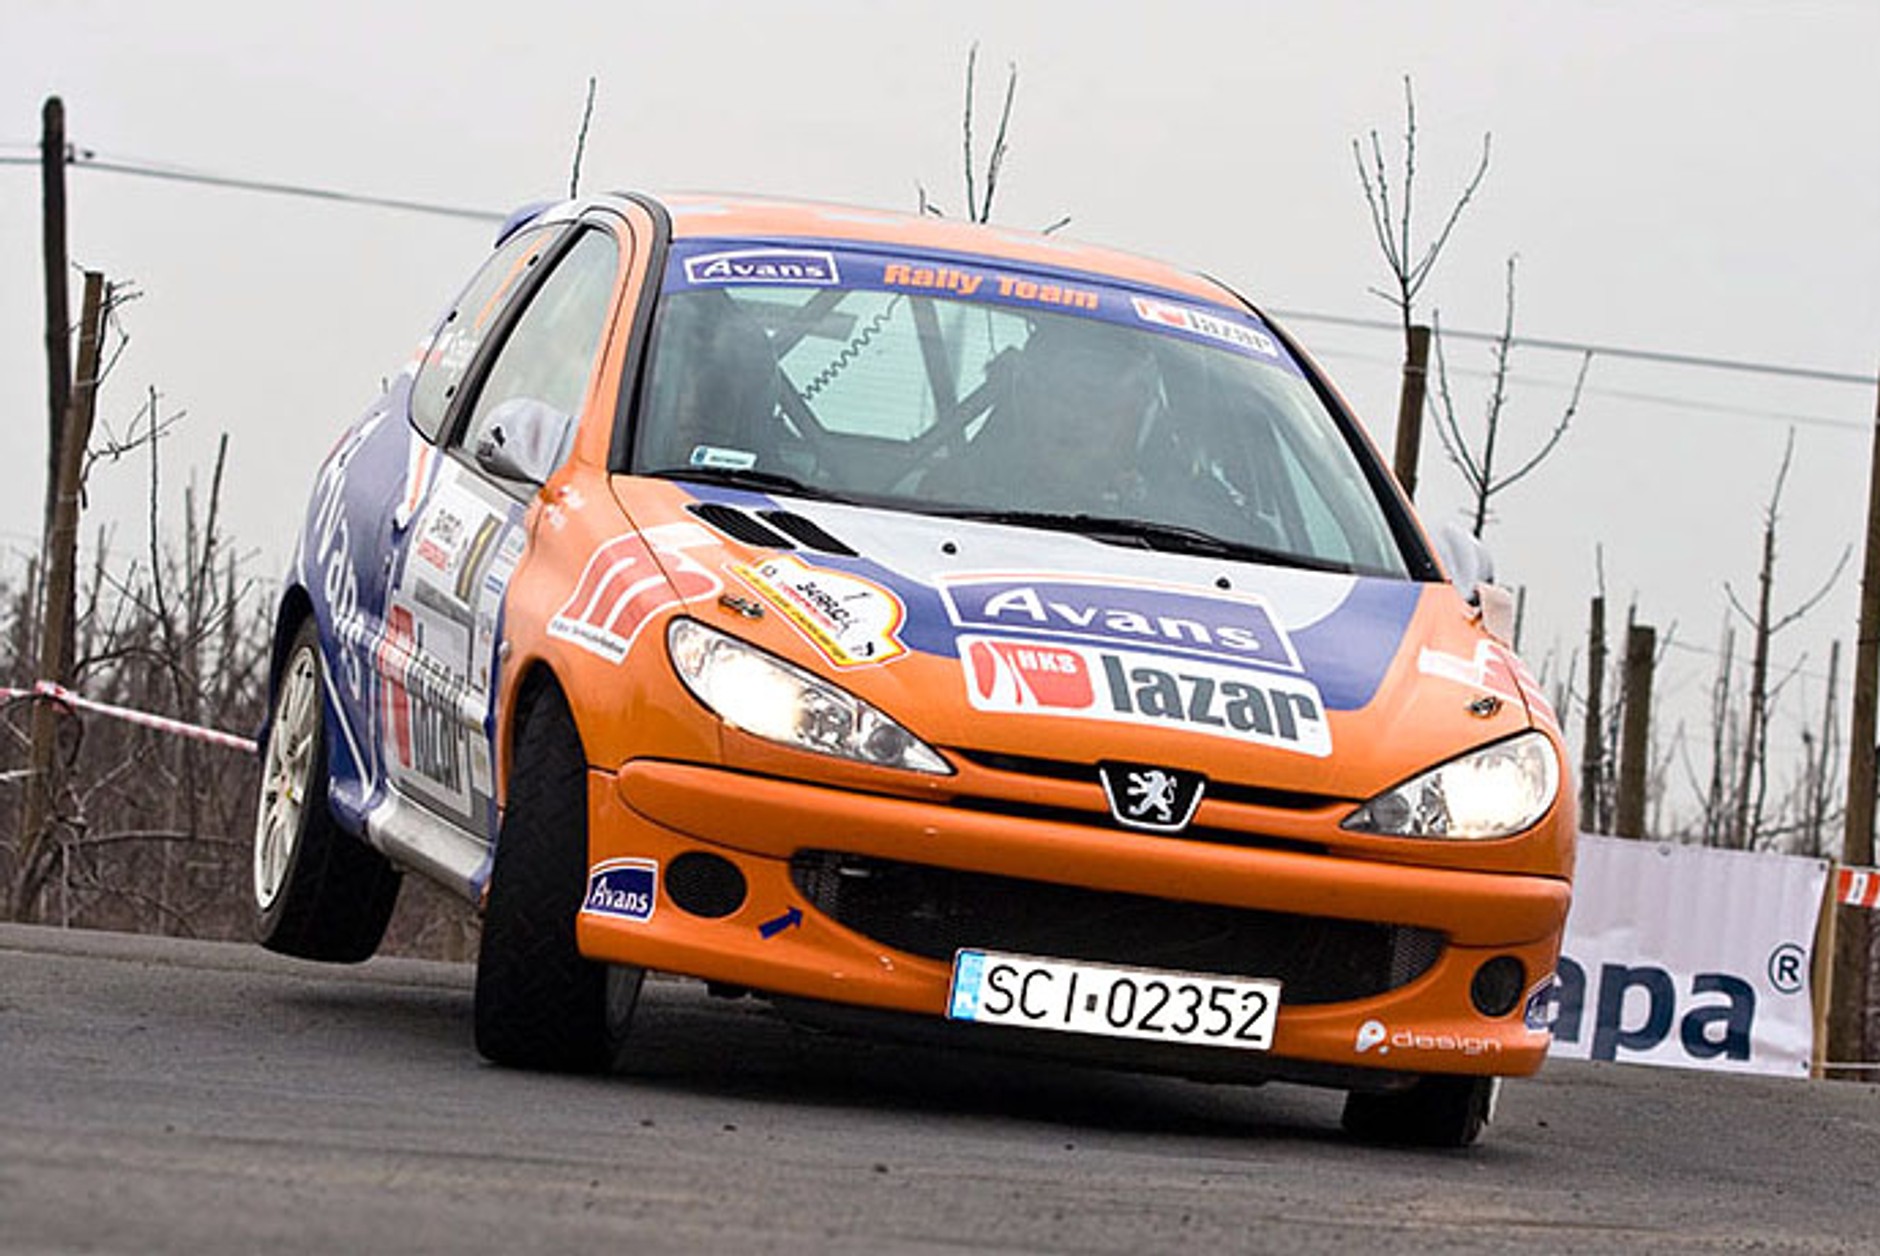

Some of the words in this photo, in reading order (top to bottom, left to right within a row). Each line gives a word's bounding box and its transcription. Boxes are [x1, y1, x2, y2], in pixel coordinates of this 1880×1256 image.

[703, 259, 825, 277] Avans
[884, 263, 983, 295] Rally
[997, 275, 1099, 310] Team
[984, 587, 1261, 650] Avans
[1019, 652, 1079, 675] HKS
[1100, 655, 1320, 741] lazar
[589, 876, 648, 913] Avans
[984, 964, 1079, 1022] SCI
[1105, 978, 1268, 1042] 02352
